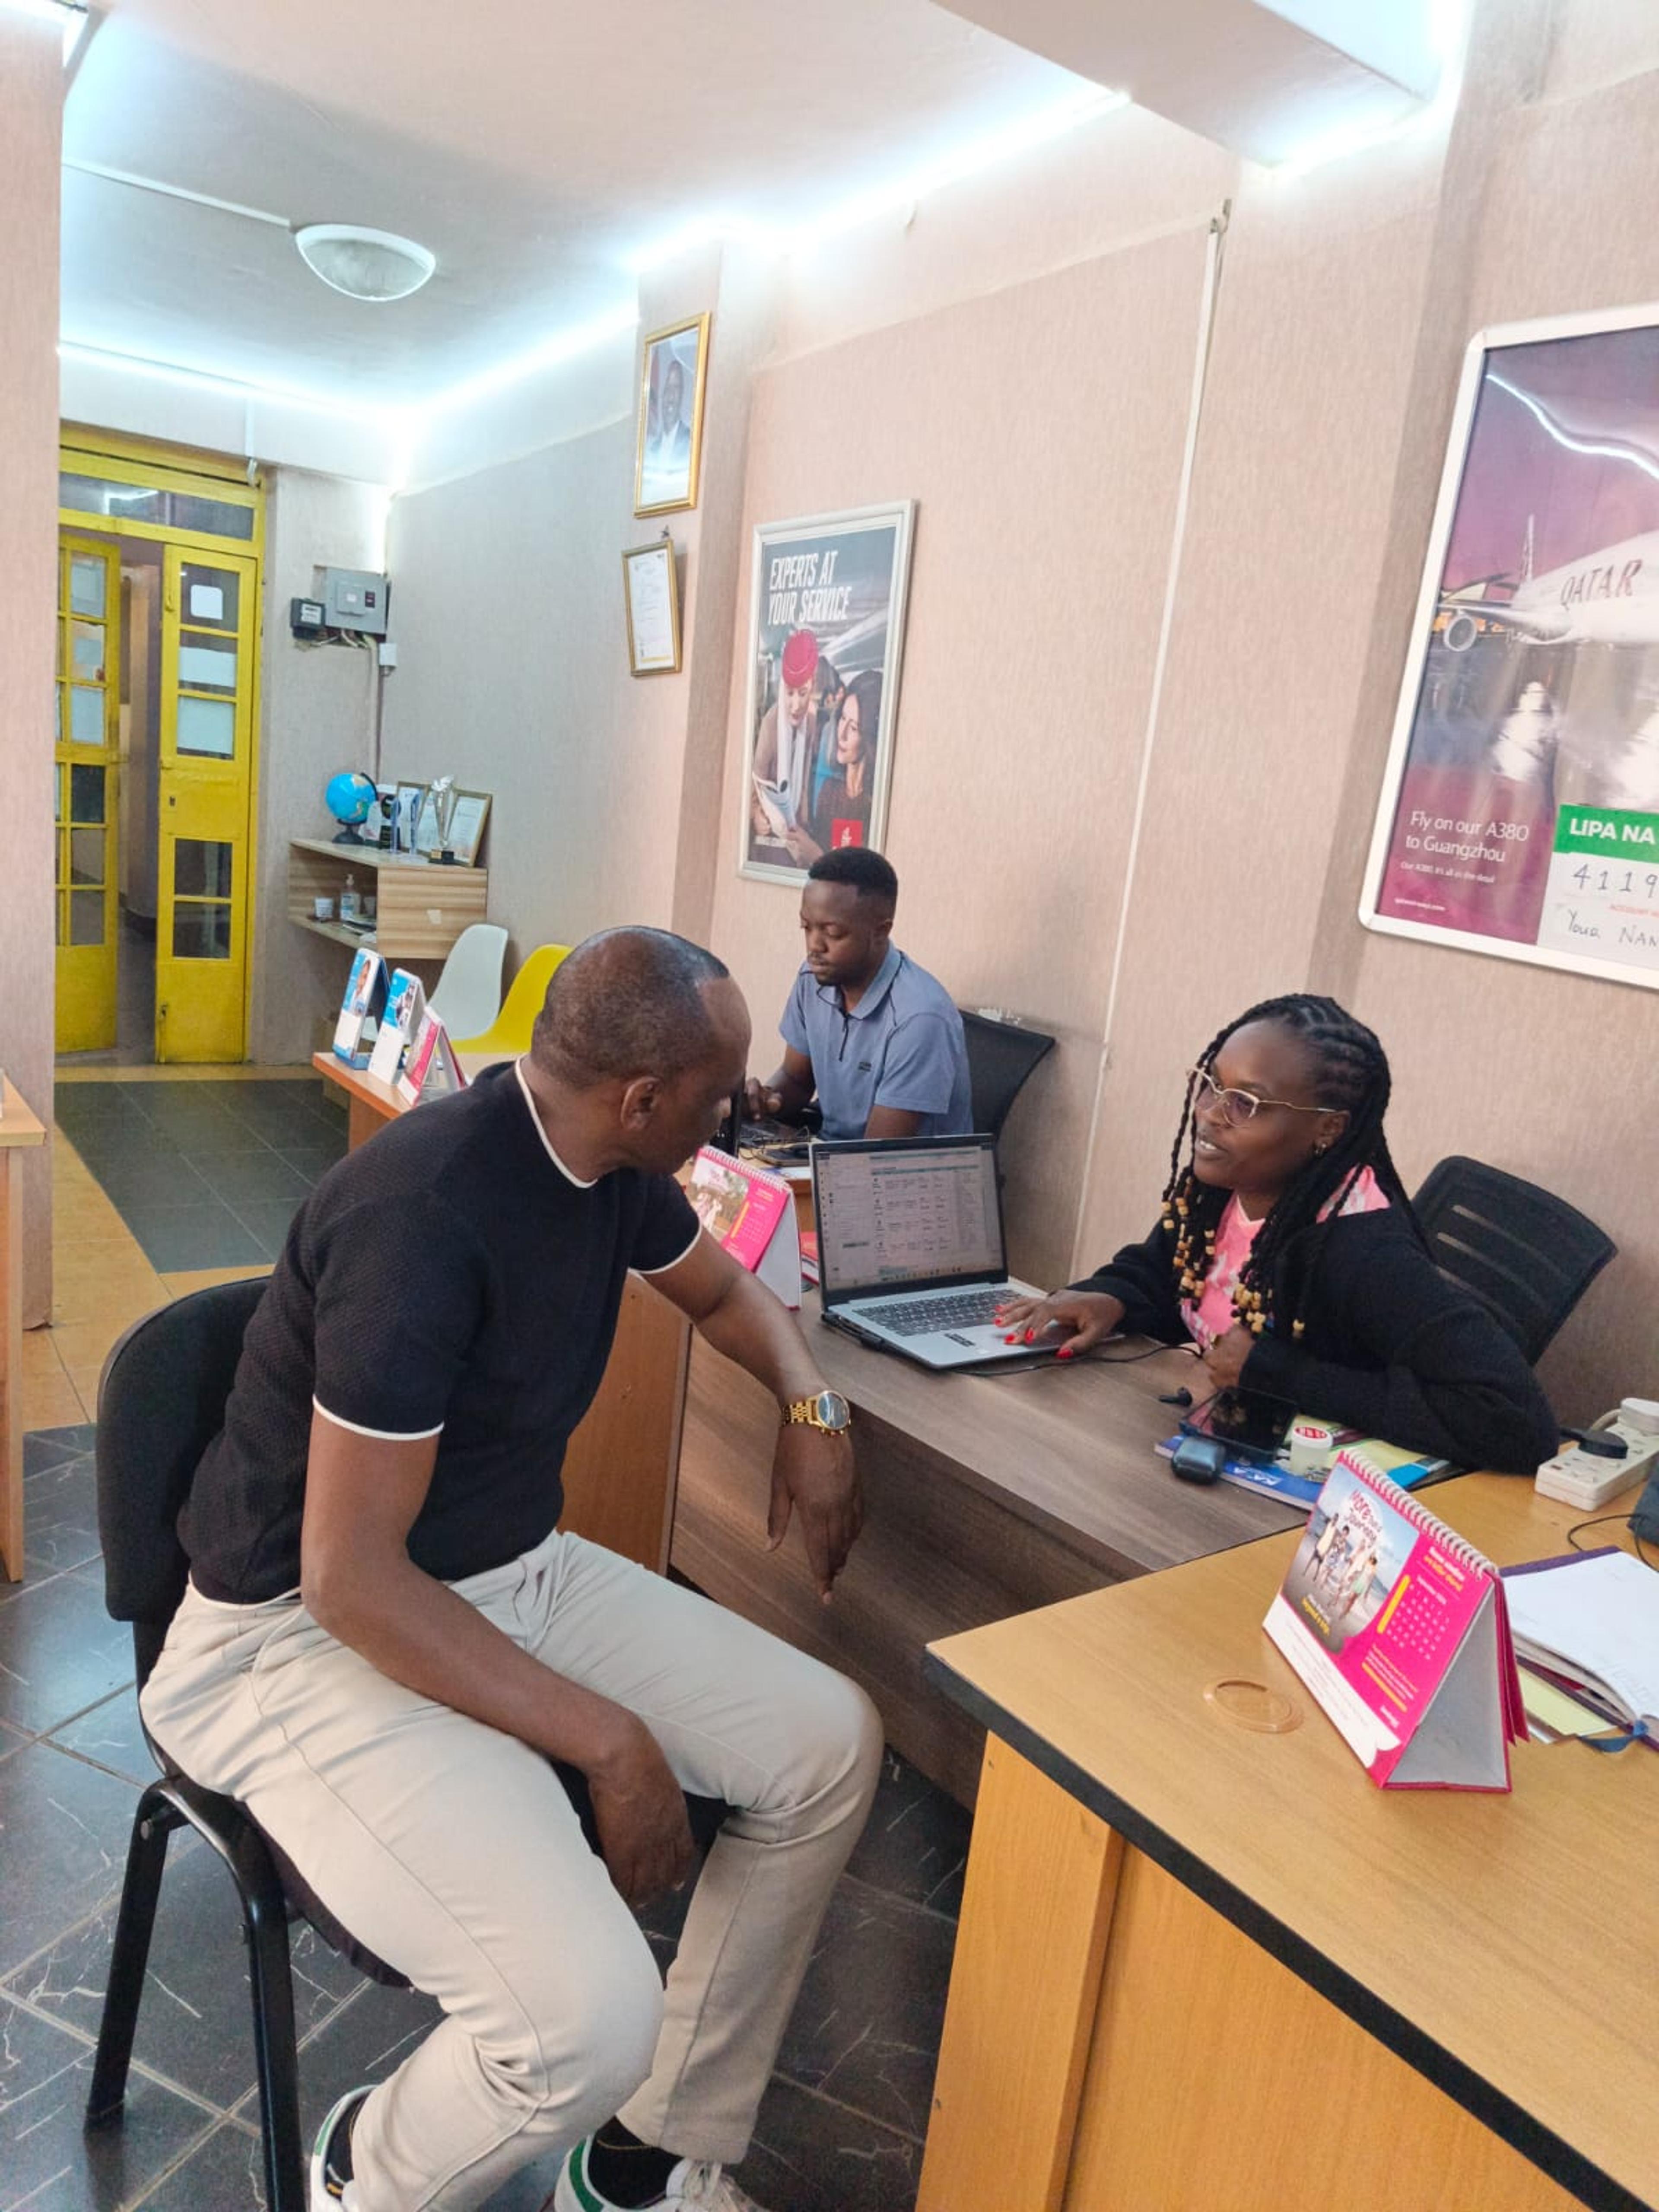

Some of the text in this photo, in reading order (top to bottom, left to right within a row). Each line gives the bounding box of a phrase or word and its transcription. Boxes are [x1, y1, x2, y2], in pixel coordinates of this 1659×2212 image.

[769, 550, 838, 591] EXPERTS AT
[1560, 559, 1643, 611] QATAR
[768, 586, 852, 625] YOUR SERVICE
[1410, 810, 1529, 841] Fly on our A380
[1570, 818, 1656, 845] LIPA NA
[1405, 835, 1506, 862] to Guangzhou
